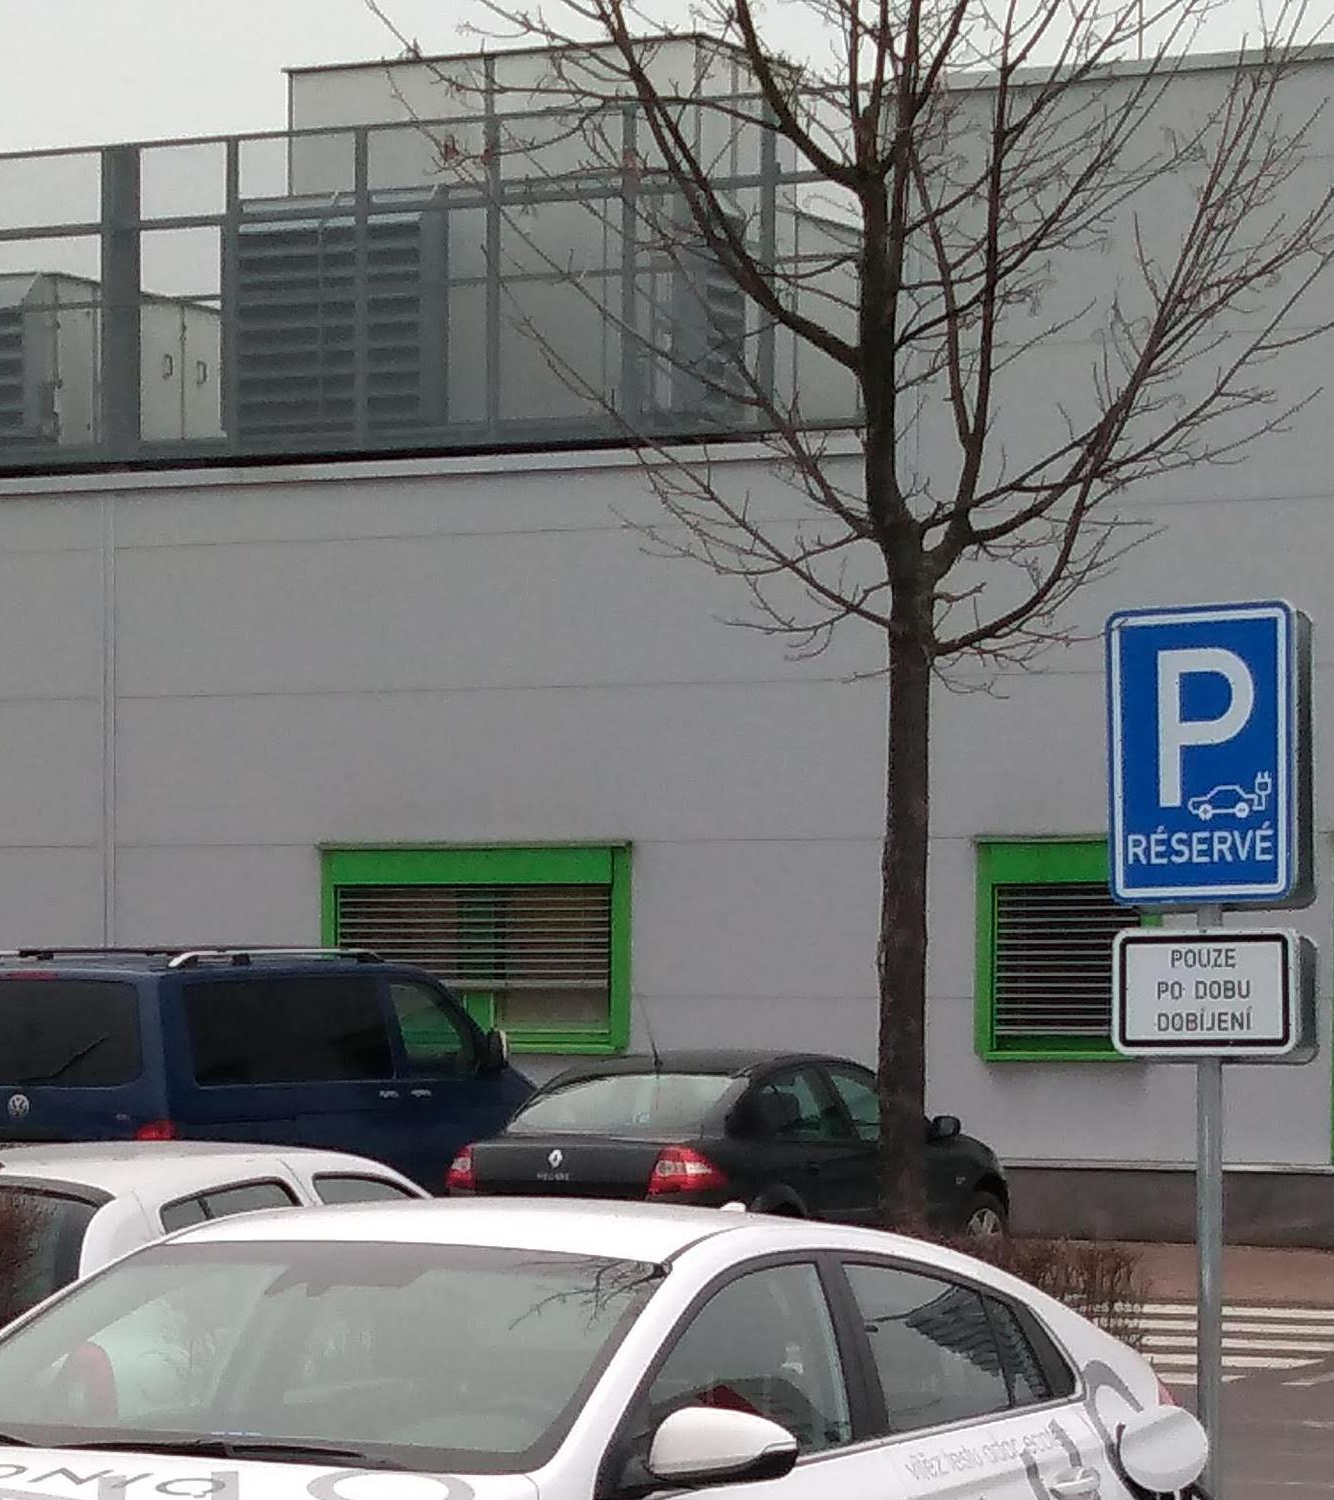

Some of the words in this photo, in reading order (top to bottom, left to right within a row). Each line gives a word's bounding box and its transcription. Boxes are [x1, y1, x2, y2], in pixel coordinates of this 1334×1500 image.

[1157, 647, 1255, 808] P
[1126, 820, 1275, 866] RÉSERVÉ
[1170, 947, 1237, 969] POUZE
[1157, 980, 1183, 1000] PO
[1194, 980, 1251, 1000] DOBU
[1157, 1006, 1253, 1032] DOBÍJENÍ
